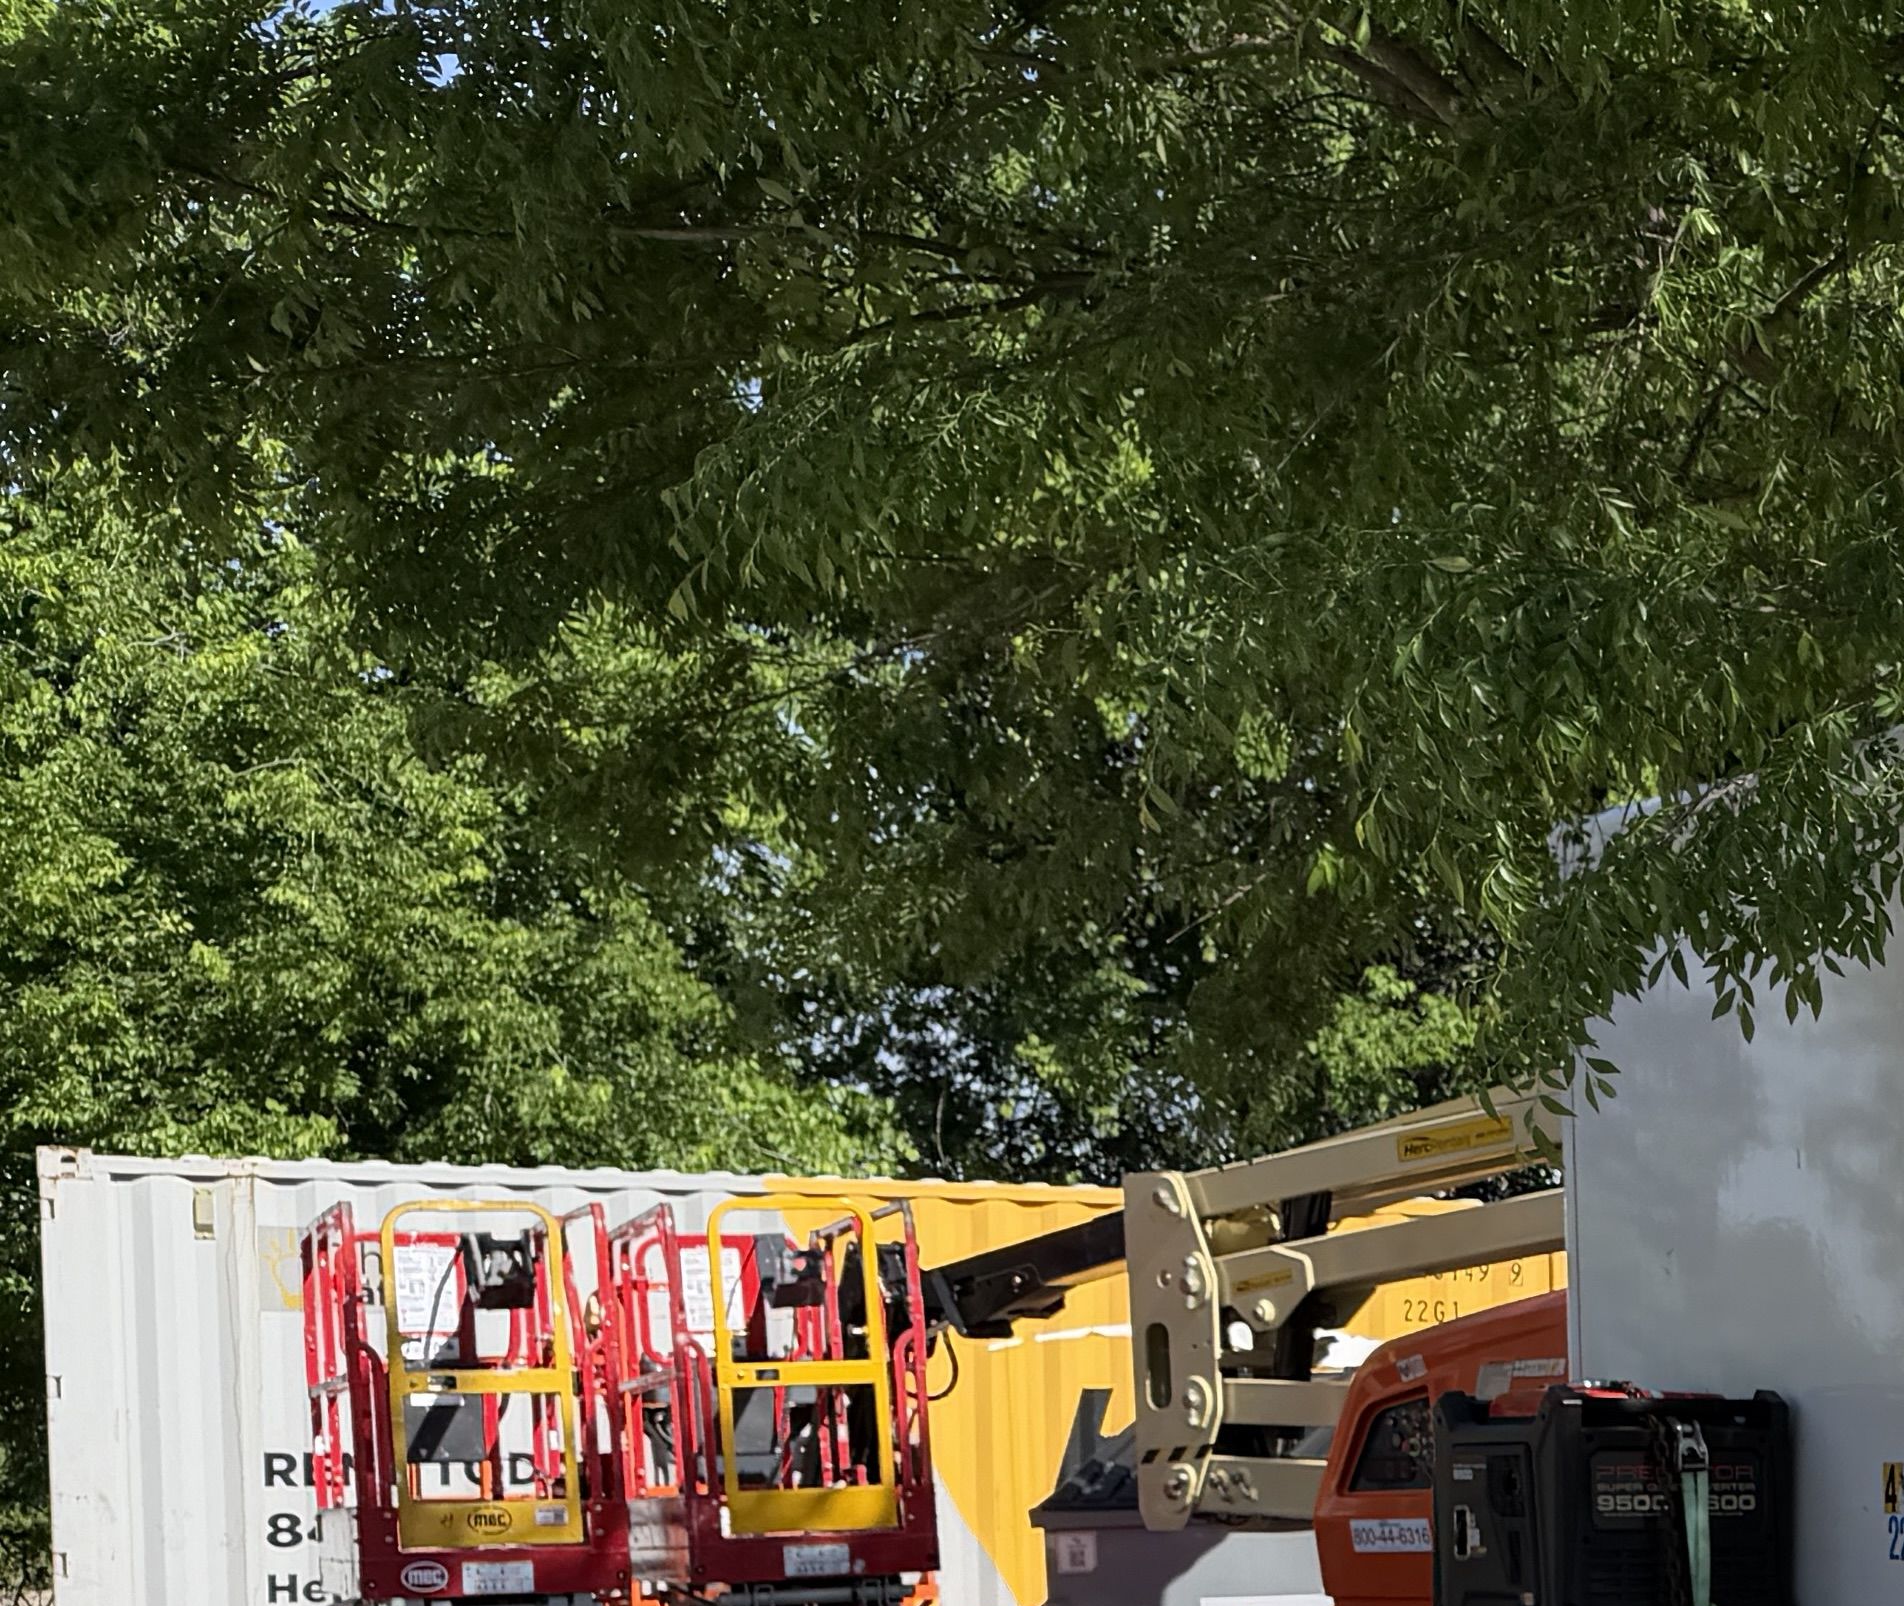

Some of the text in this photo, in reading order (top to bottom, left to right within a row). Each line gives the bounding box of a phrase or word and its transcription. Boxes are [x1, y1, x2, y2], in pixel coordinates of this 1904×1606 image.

[1404, 1299, 1460, 1324] 22G1
[1596, 1465, 1754, 1480] PREOR
[1596, 1483, 1643, 1492] SUPER
